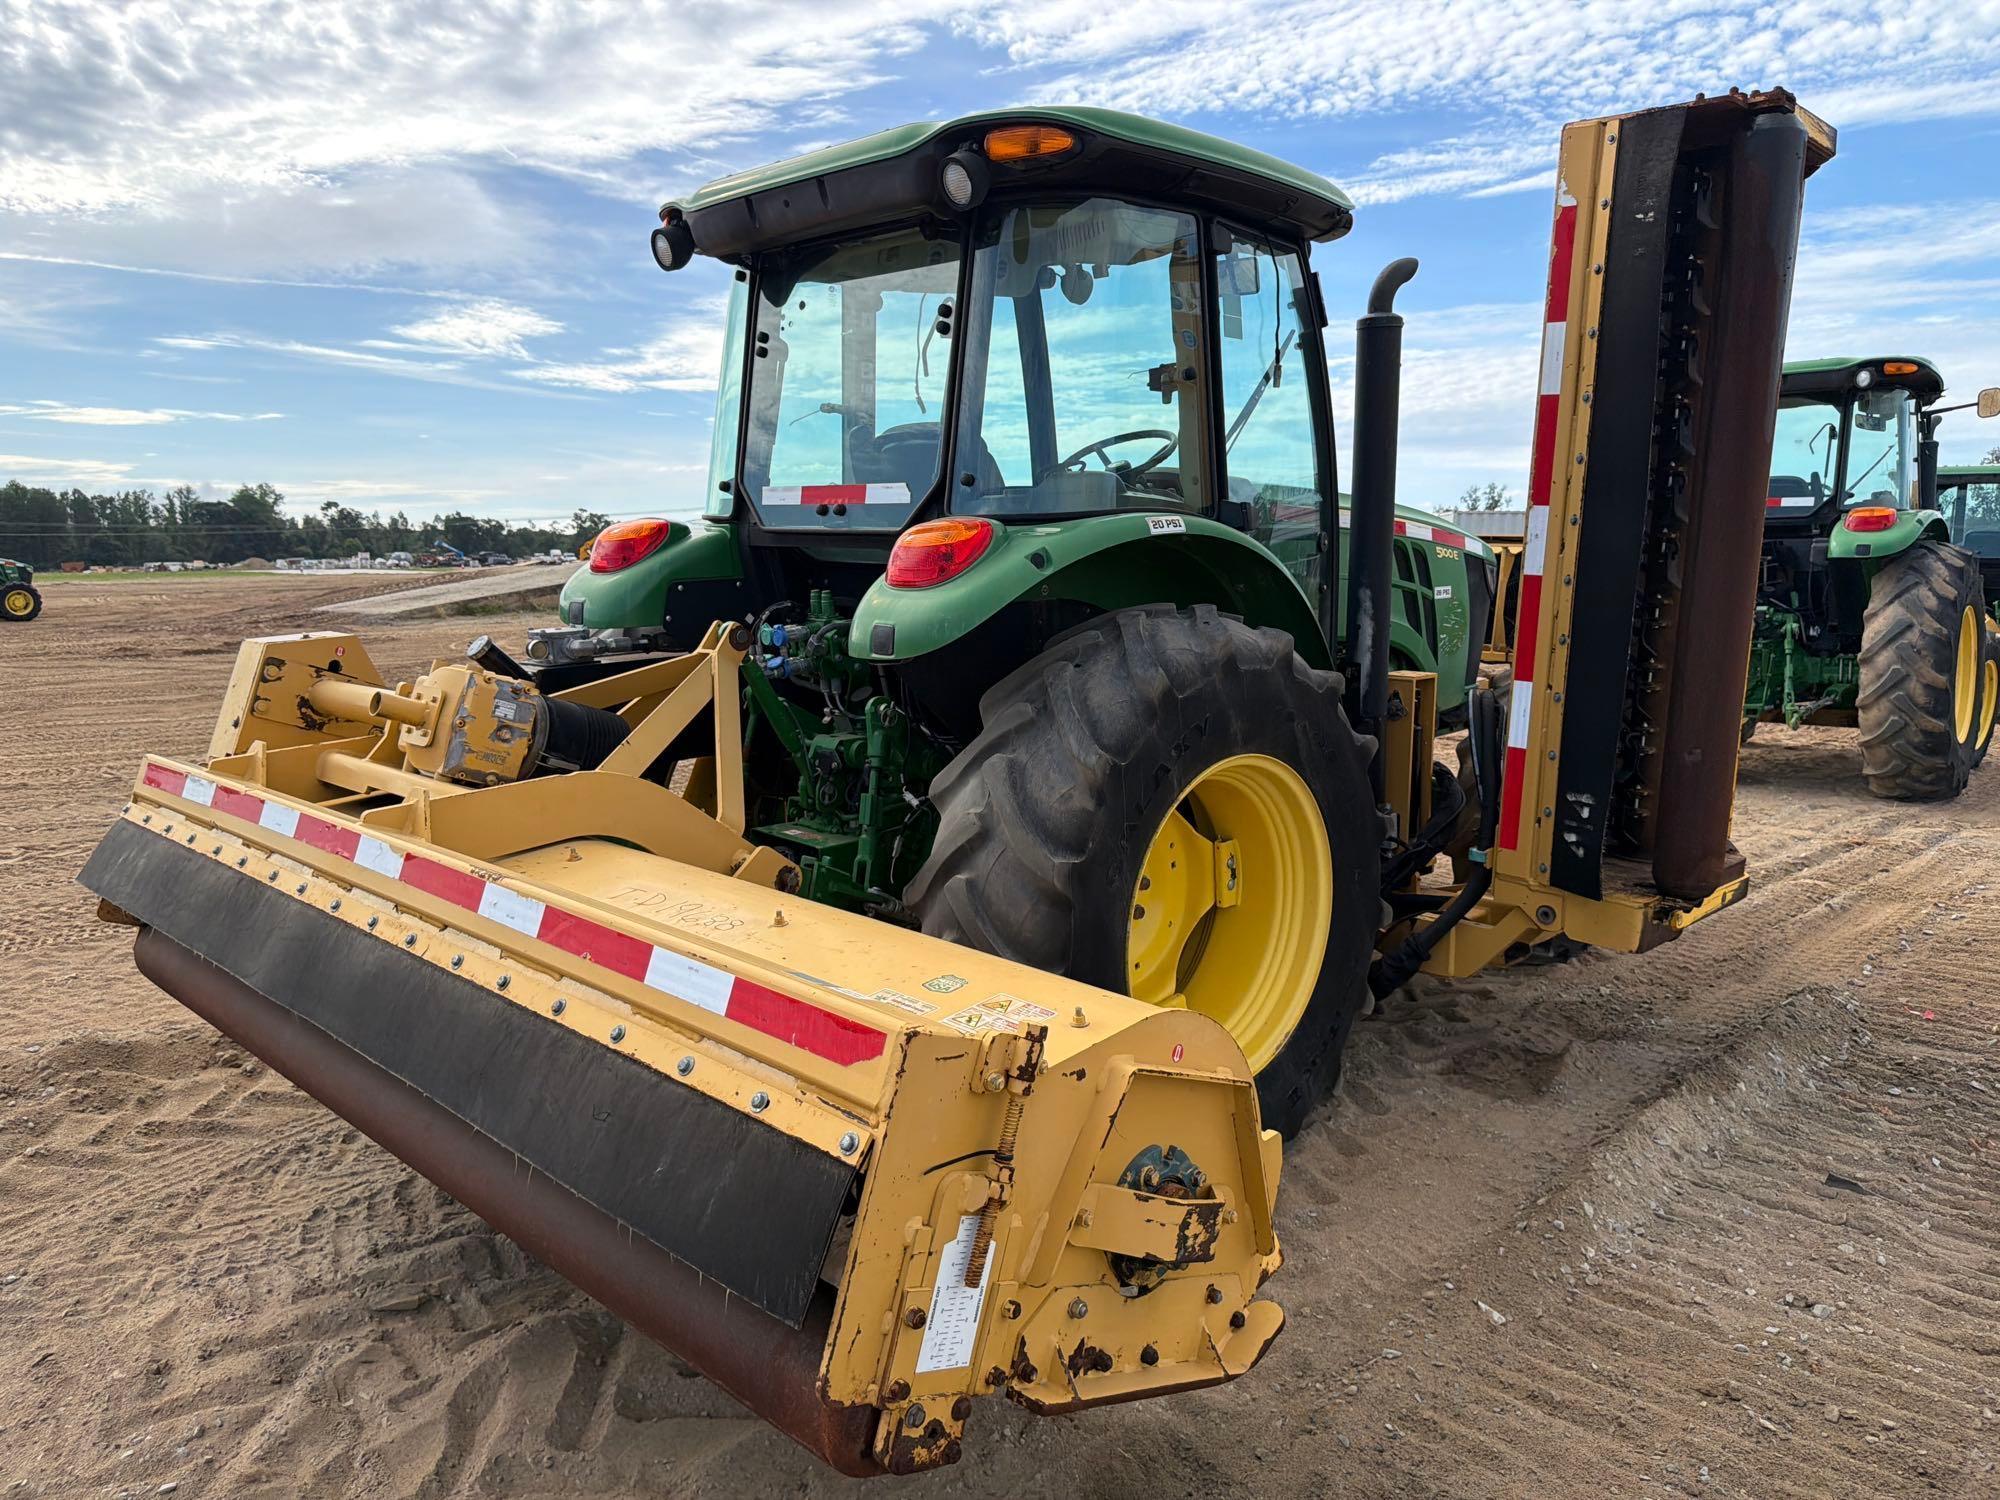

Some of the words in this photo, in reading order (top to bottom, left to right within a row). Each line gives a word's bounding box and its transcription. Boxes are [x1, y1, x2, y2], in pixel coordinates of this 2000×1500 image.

[1151, 520, 1164, 529] 20
[1165, 519, 1182, 528] PSI
[928, 1299, 938, 1330] STANDARD
